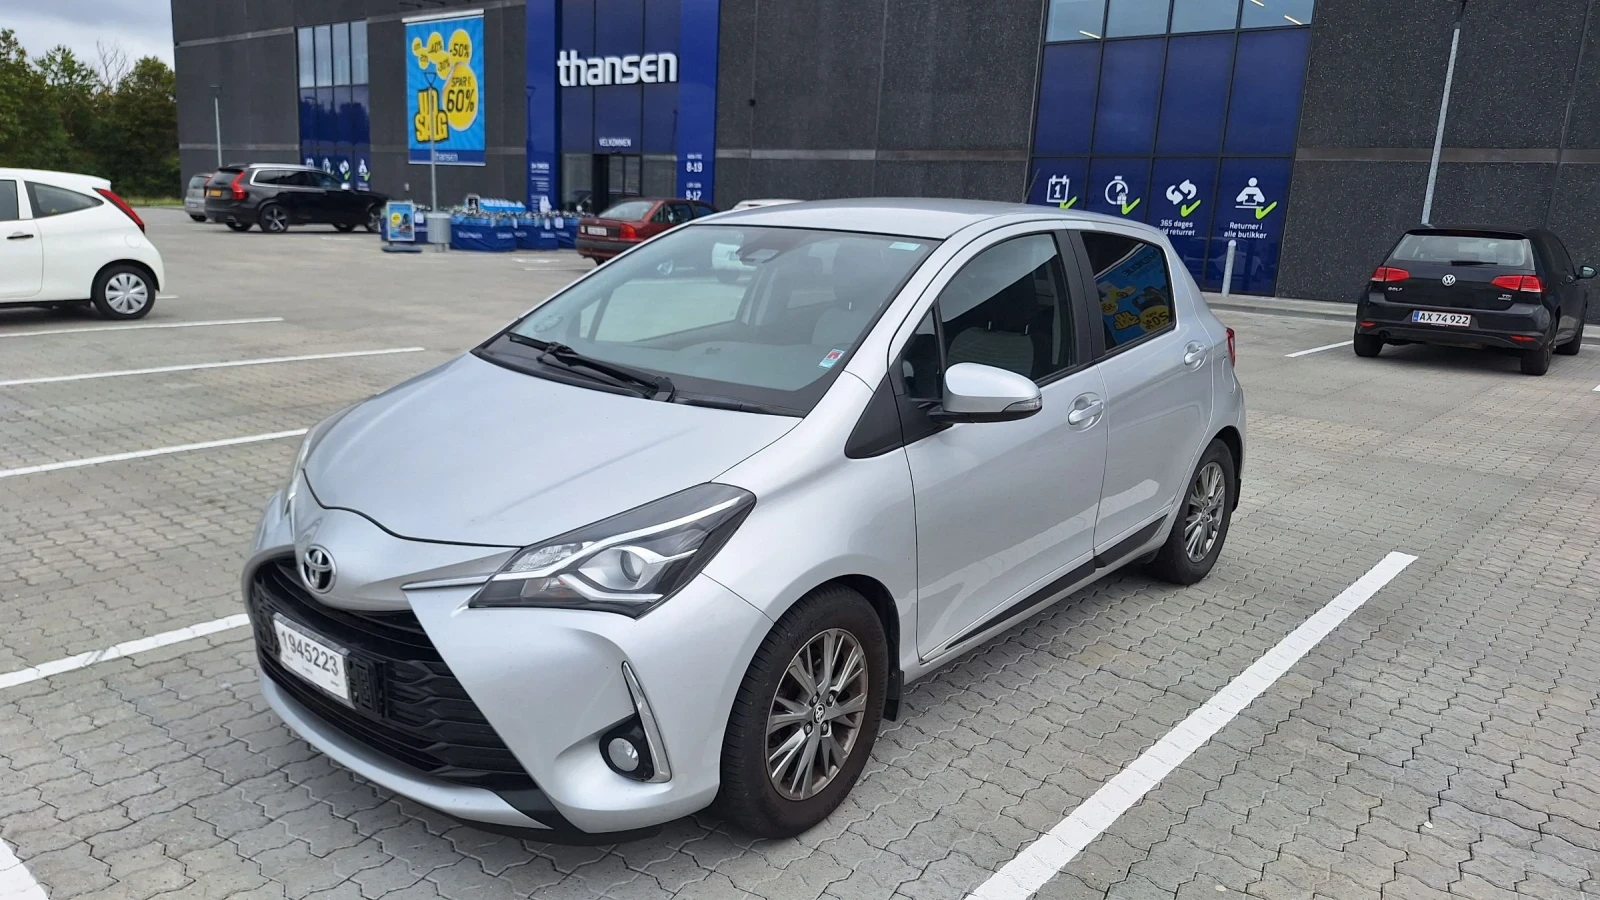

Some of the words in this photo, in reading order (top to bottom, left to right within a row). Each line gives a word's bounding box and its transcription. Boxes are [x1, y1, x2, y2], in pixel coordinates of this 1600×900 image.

[450, 43, 469, 58] -50%
[557, 50, 677, 86] thansen
[447, 89, 475, 112] 60%
[1160, 219, 1172, 227] 365
[1173, 219, 1193, 229] dages
[1229, 222, 1259, 230] Returner
[1170, 228, 1195, 236] returret
[1238, 231, 1267, 239] butikker
[1419, 312, 1433, 321] AX
[1435, 313, 1448, 323] 74
[1450, 315, 1468, 325] 922
[281, 631, 338, 676] 1945223
